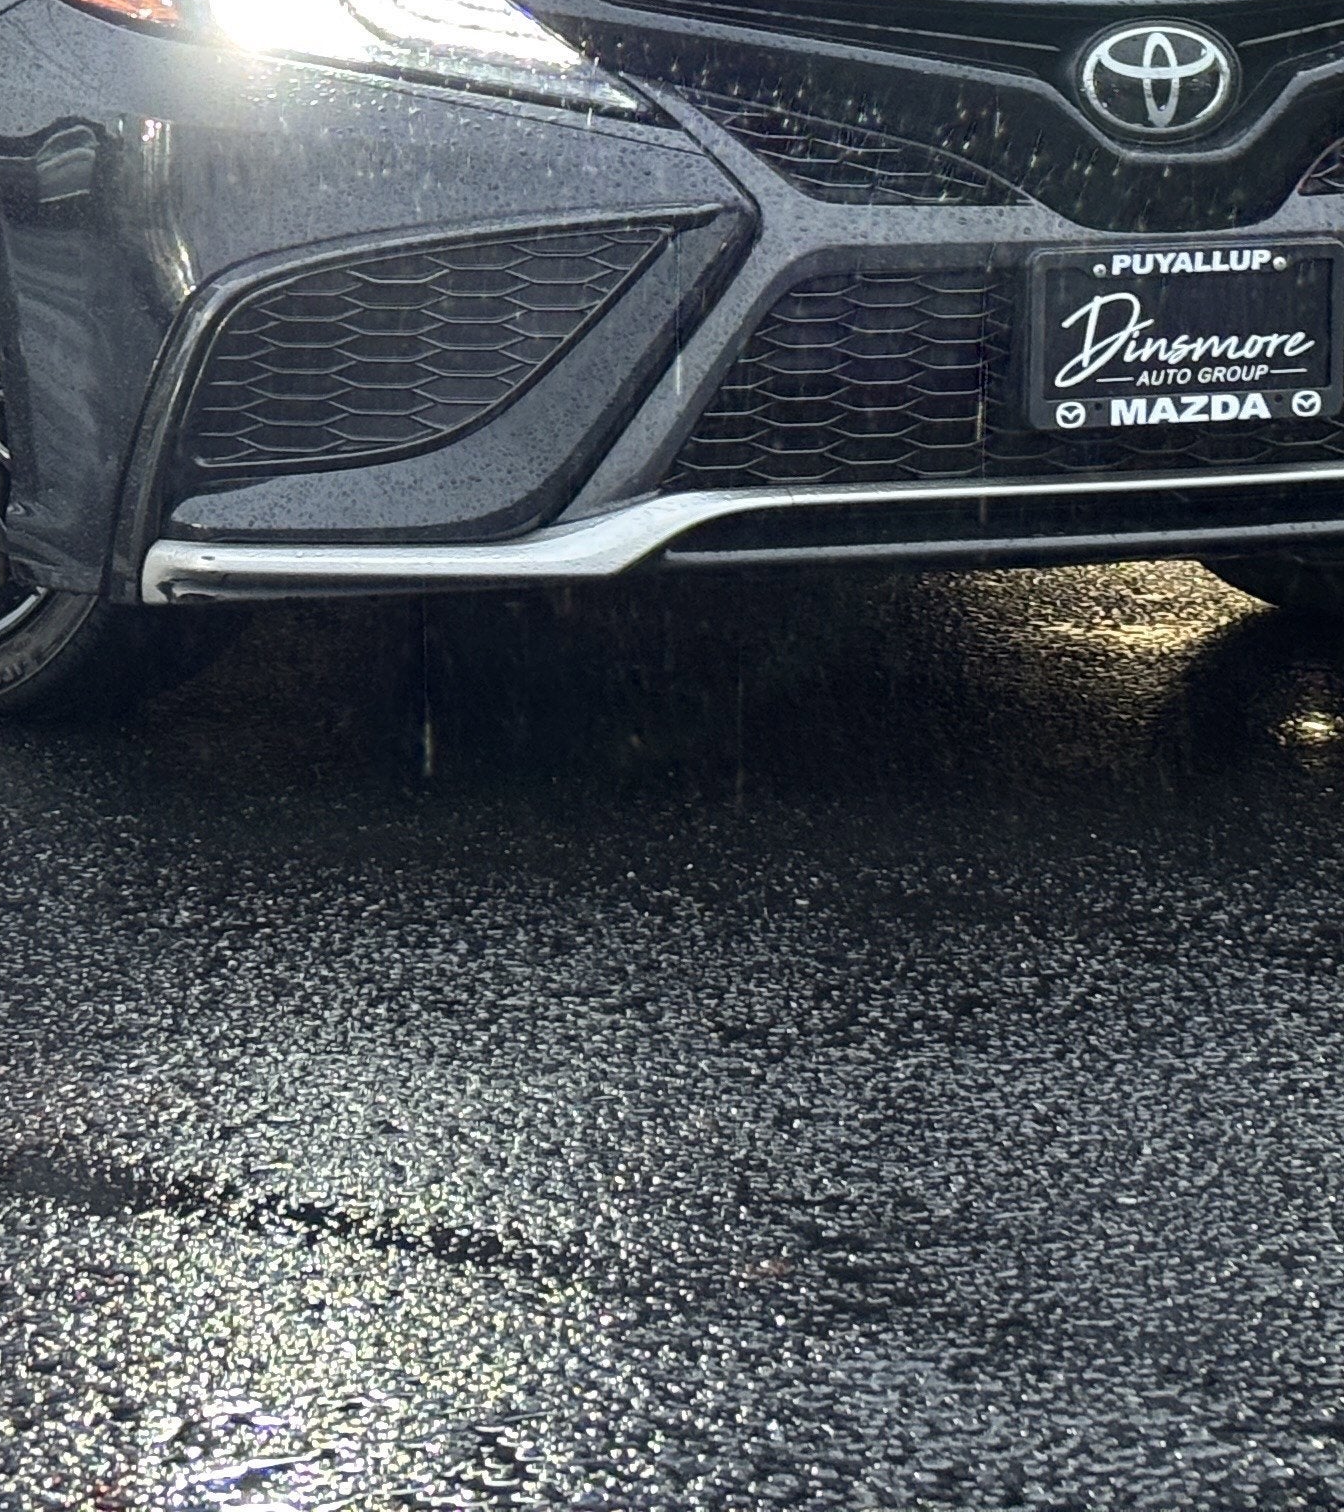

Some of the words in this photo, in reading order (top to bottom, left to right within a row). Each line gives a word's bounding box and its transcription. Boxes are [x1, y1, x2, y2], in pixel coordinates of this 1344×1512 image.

[1111, 249, 1273, 276] PUYALLUP
[1054, 292, 1316, 389] Dinsmore
[1136, 368, 1192, 387] AUTO
[1197, 364, 1269, 385] GROUP
[1109, 392, 1272, 427] MAZDA
